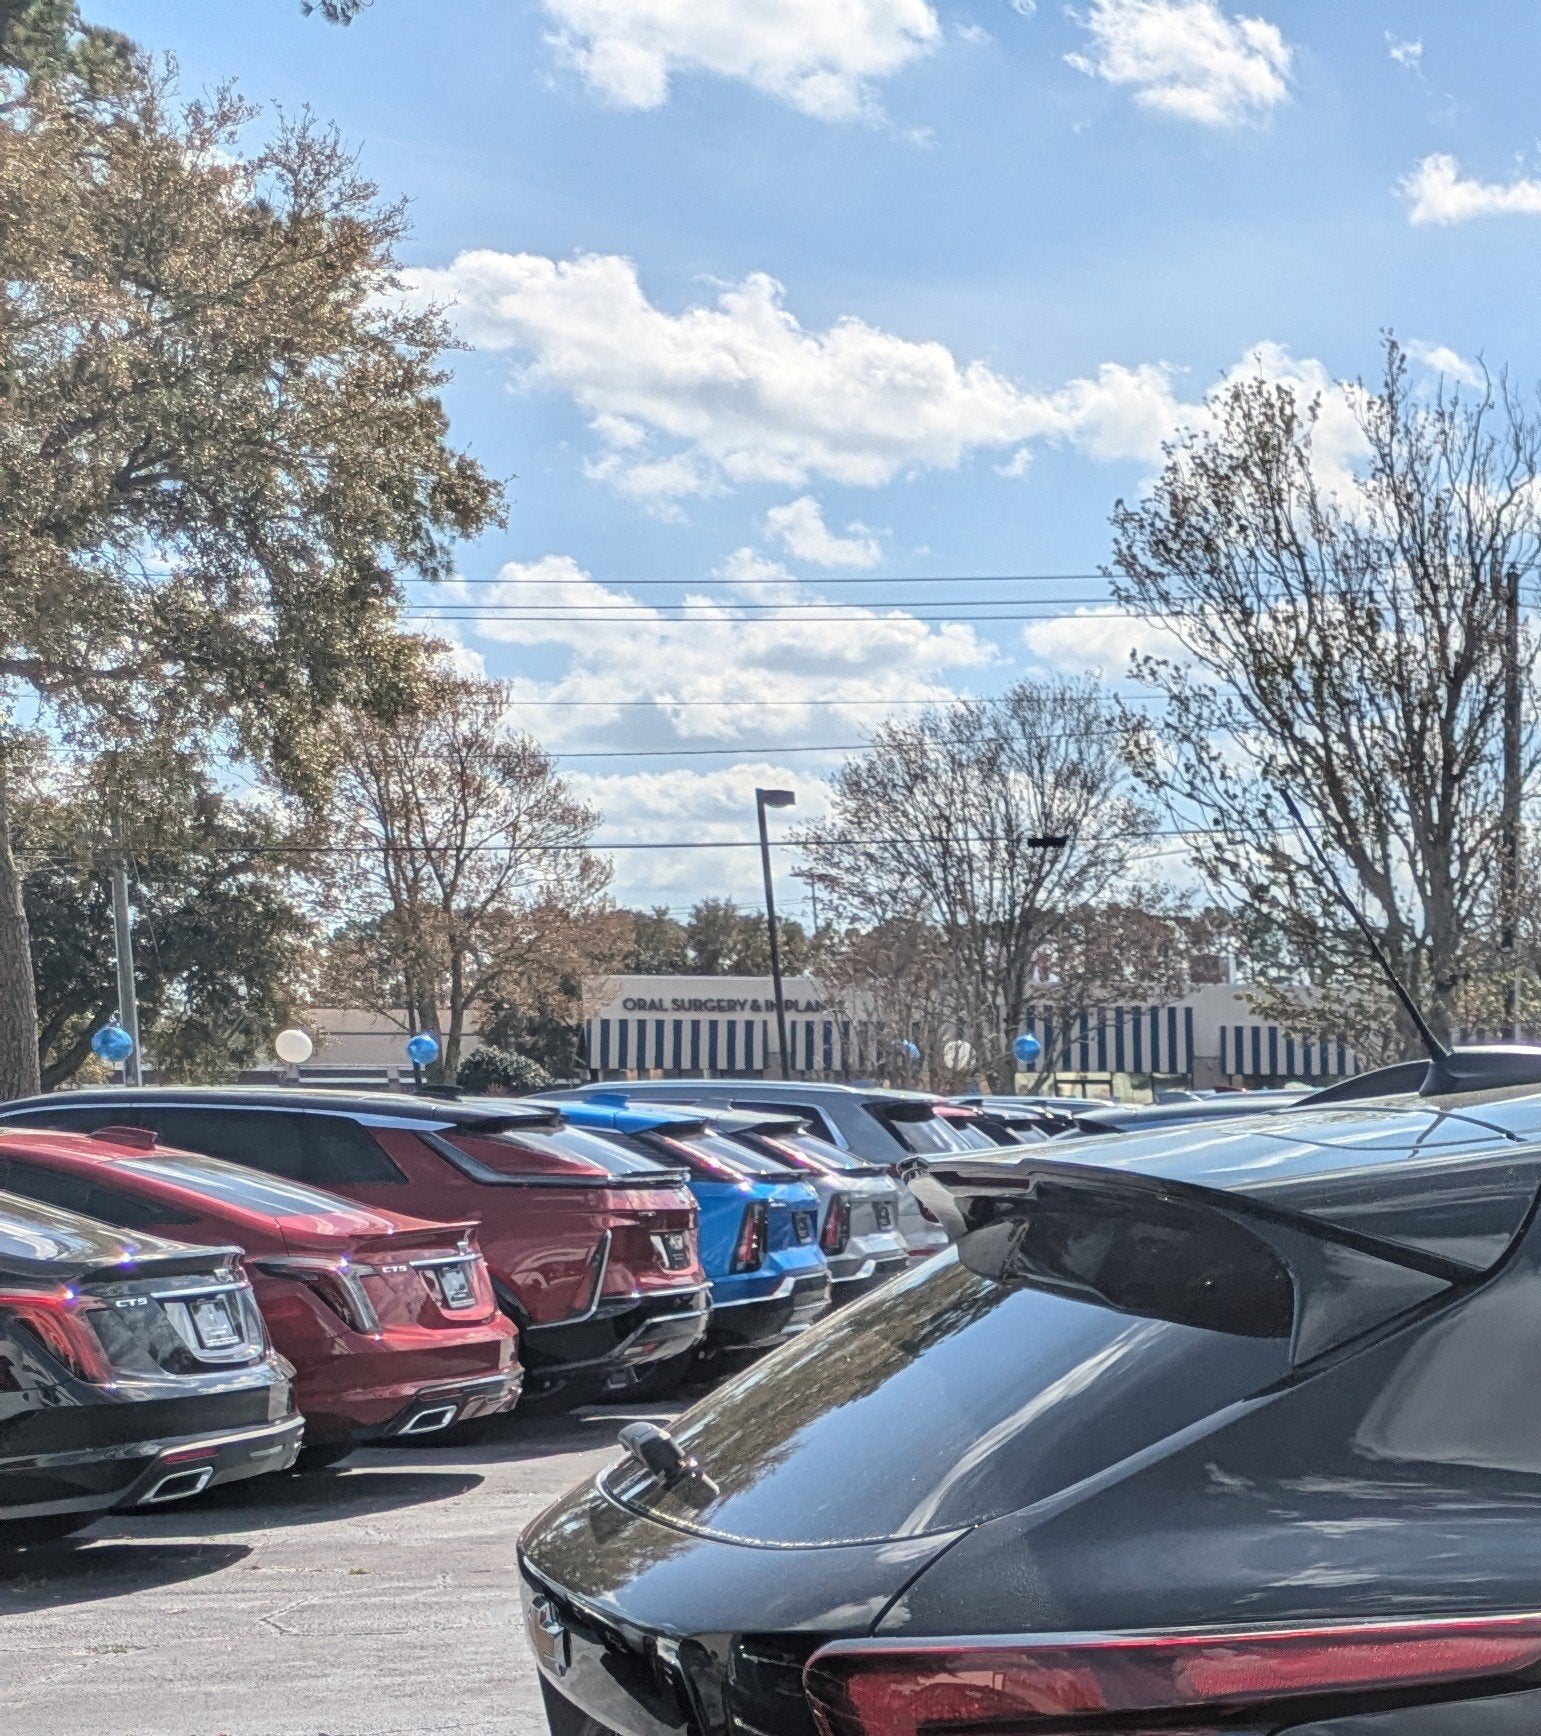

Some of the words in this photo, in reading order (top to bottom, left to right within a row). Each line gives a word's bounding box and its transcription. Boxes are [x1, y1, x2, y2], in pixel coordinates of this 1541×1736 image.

[623, 998, 669, 1011] ORAL
[671, 998, 748, 1012] SURGERY
[750, 999, 762, 1012] &
